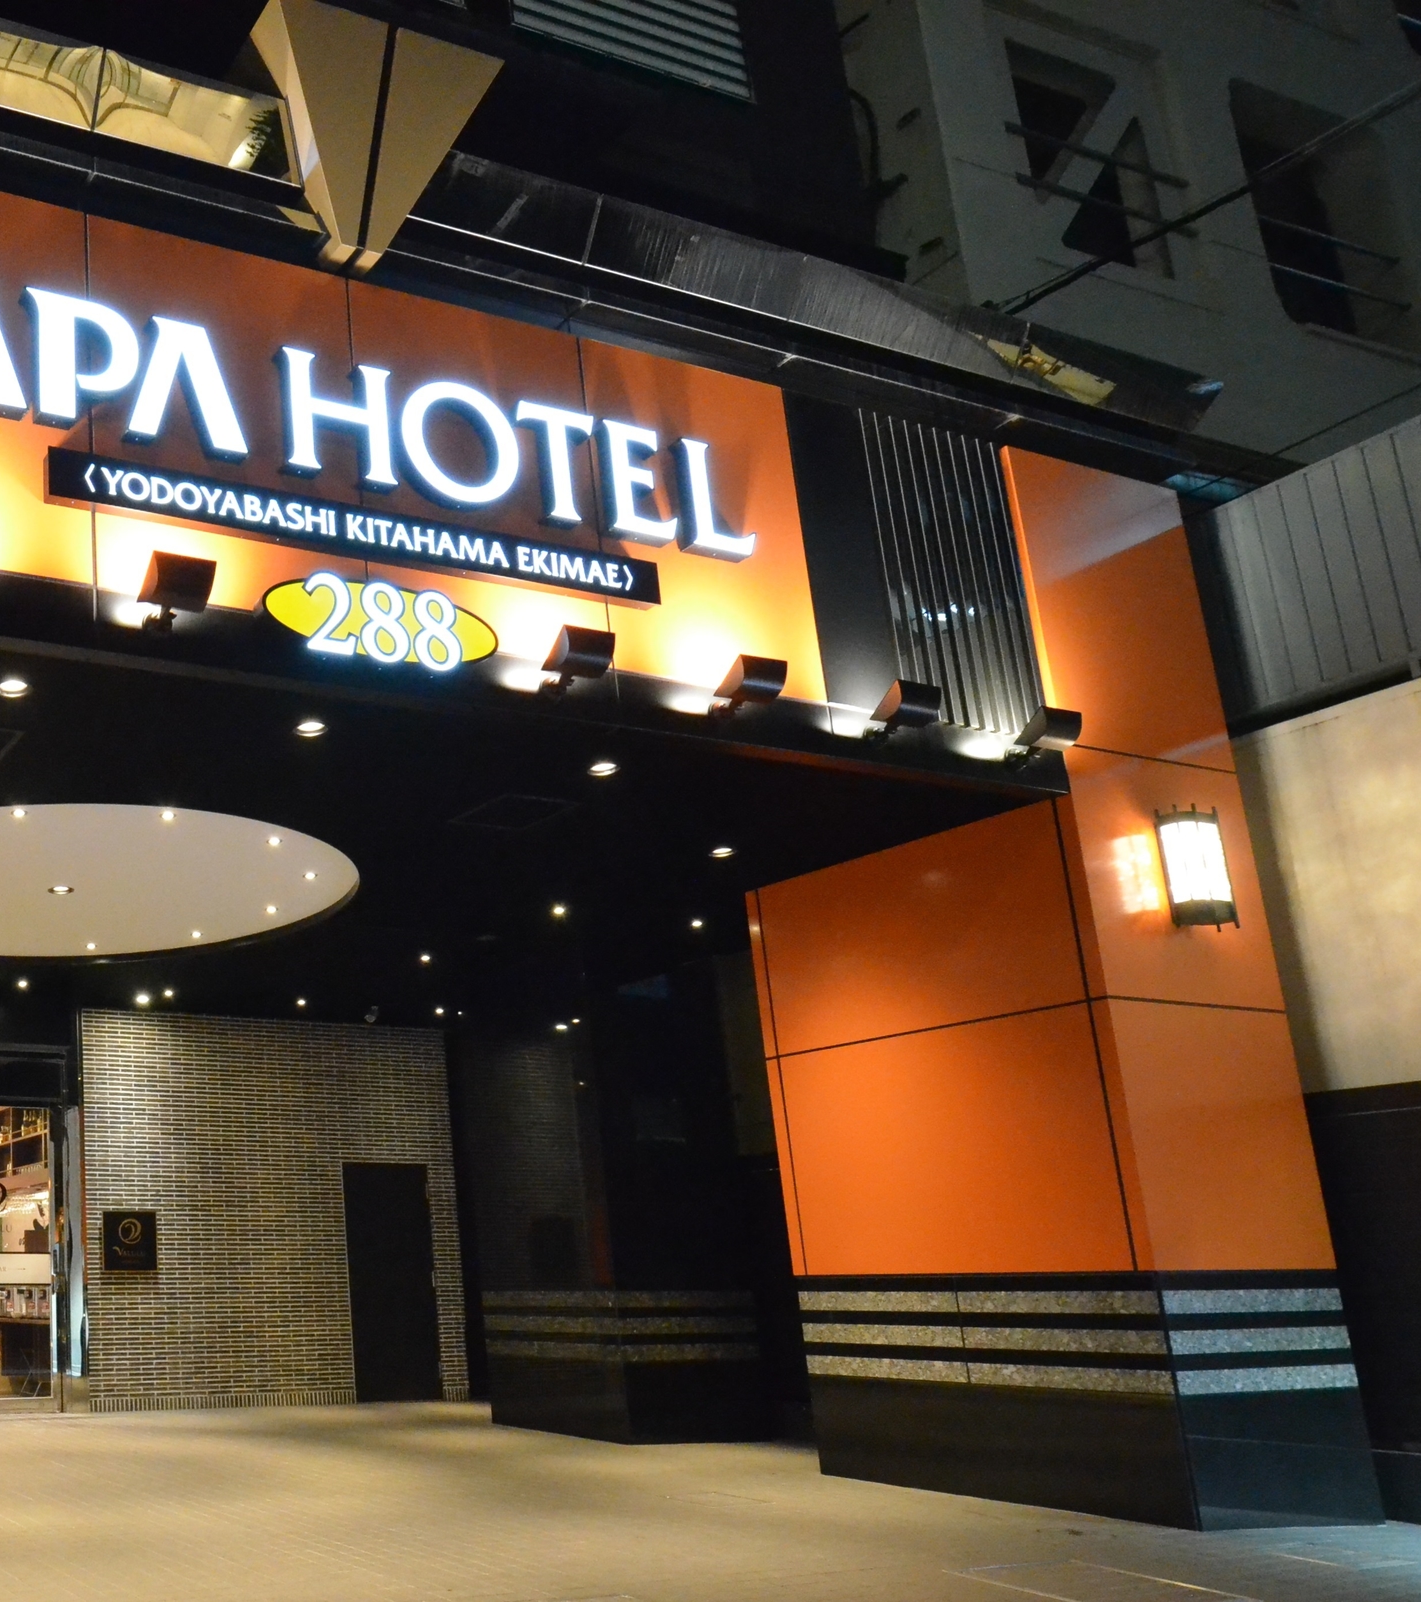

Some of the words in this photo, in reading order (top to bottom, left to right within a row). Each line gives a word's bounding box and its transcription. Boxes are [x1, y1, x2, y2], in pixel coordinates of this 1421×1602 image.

[279, 345, 756, 558] HOTEL
[346, 514, 510, 567] KITAHAMA
[303, 572, 463, 672] 288
